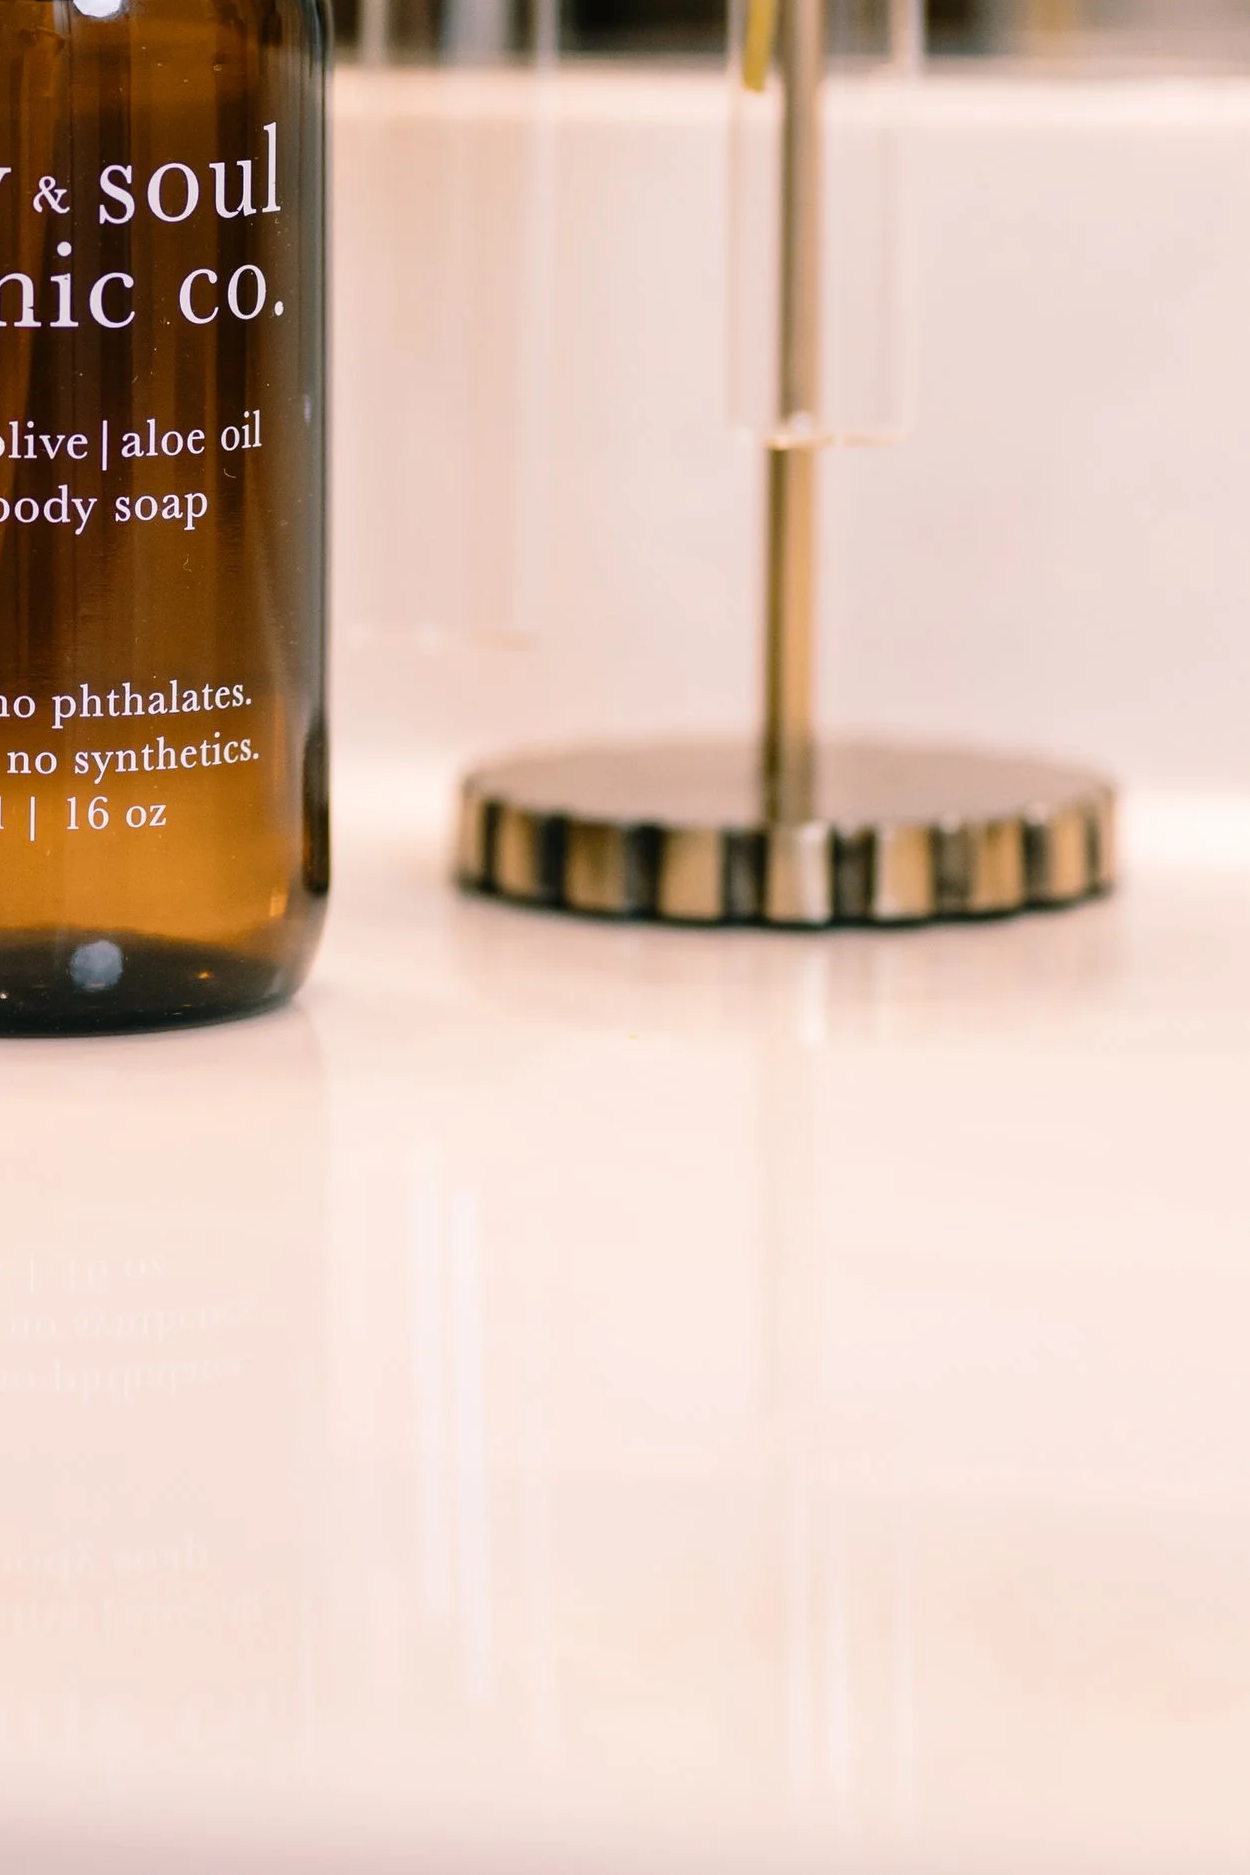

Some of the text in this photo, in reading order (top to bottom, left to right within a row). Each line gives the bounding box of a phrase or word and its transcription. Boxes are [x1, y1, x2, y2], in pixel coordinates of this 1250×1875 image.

[33, 176, 70, 213] &
[99, 122, 280, 224] soul
[180, 265, 284, 324] co.
[122, 419, 205, 457] aloe
[221, 410, 262, 451] oil
[116, 493, 207, 530] soap
[52, 680, 251, 729] phthalates.
[7, 752, 57, 774] no
[75, 732, 258, 784] synthetics.
[67, 796, 109, 829] 16
[126, 805, 166, 828] oz
